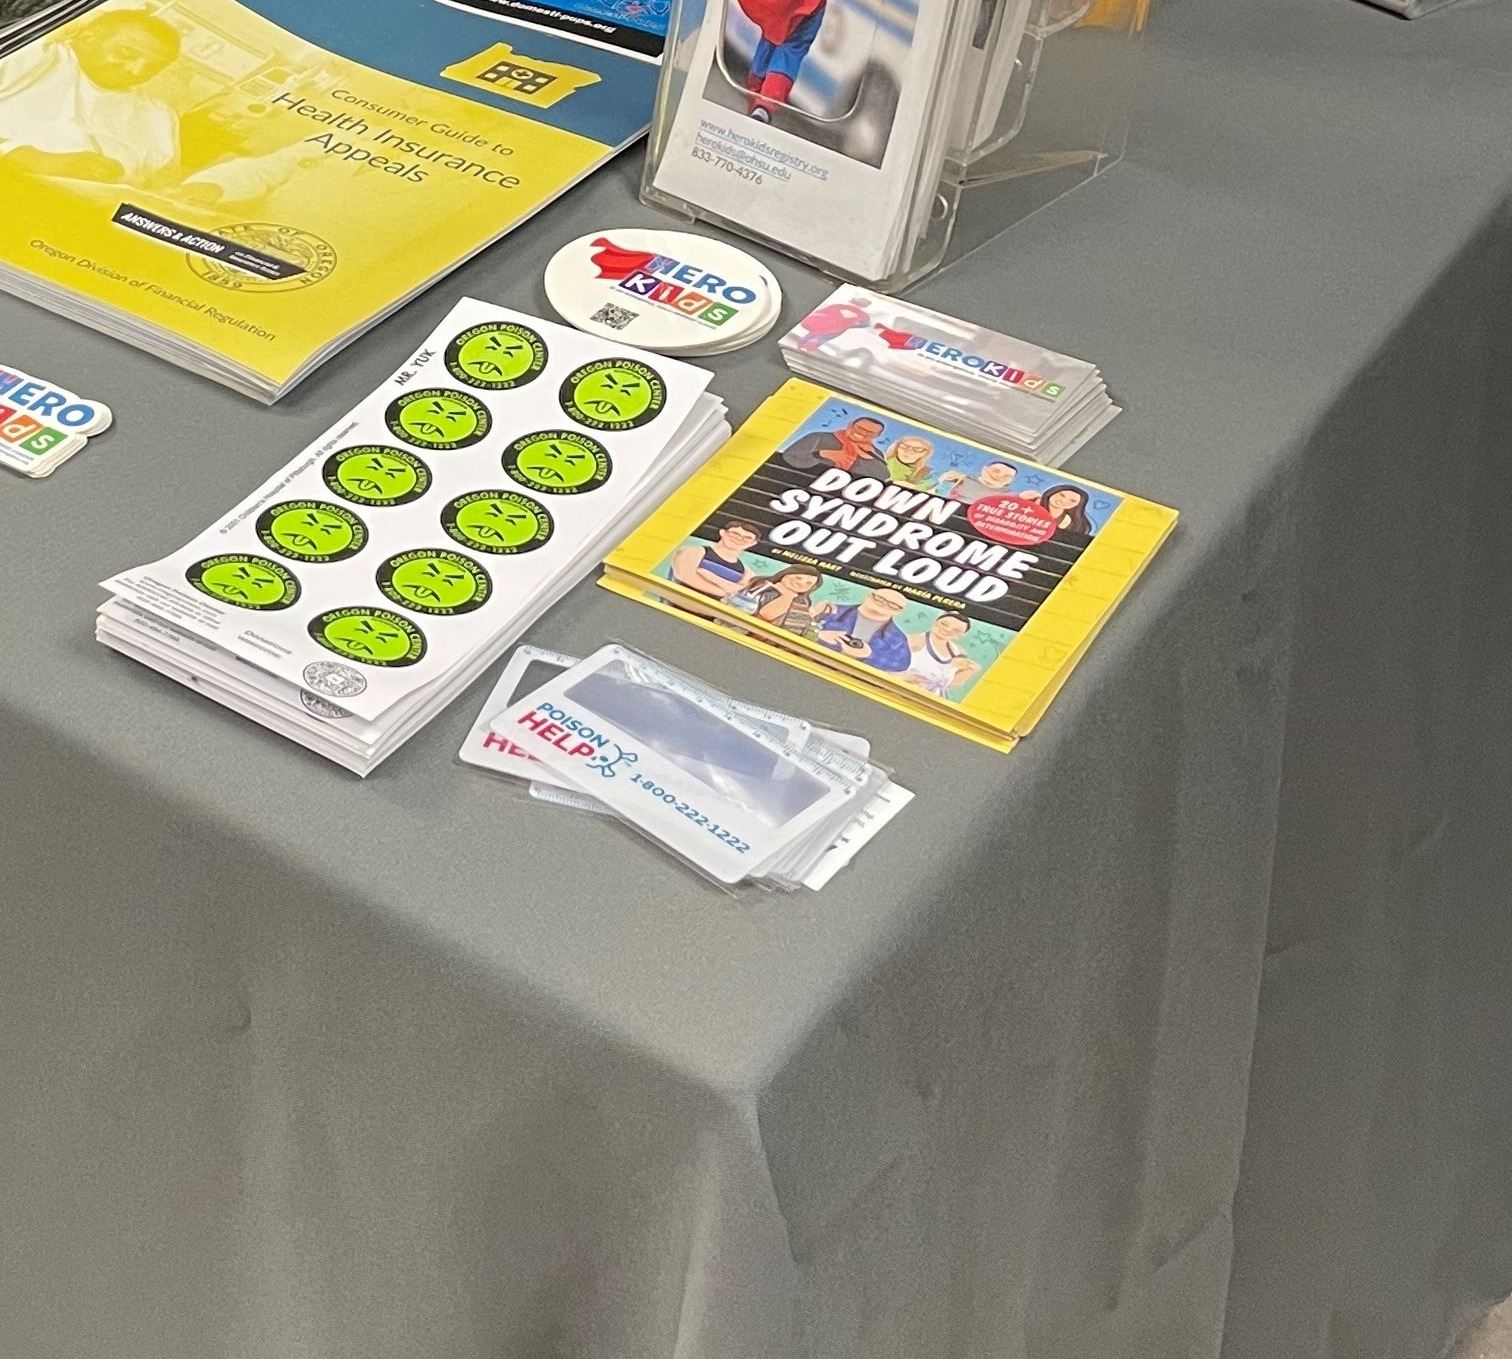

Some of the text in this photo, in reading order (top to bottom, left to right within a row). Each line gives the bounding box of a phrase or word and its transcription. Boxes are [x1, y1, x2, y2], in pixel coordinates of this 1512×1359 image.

[272, 92, 520, 189] Health Insurance
[331, 89, 514, 156] Consumer Guide to
[305, 133, 429, 183] Appeals
[691, 146, 763, 186] 833-770-4376
[120, 212, 225, 253] ANSWERS & ACTION
[30, 240, 76, 263] Oregon
[77, 259, 128, 282] Division
[144, 284, 206, 312] Financial
[205, 306, 276, 341] Regulation
[620, 272, 735, 327] Kids
[646, 253, 756, 307] HERO
[411, 349, 437, 368] YUK
[456, 324, 546, 370] OREGON POISON CENTER
[810, 467, 960, 524] DOWN
[976, 504, 1004, 516] TRUE
[1005, 512, 1051, 528] STORIES
[999, 500, 1019, 511] 20
[769, 489, 1038, 579] SYNDROME
[782, 550, 818, 566] MELISSA
[768, 520, 1008, 602] OUT LOUD
[517, 710, 595, 759] HELP
[536, 702, 609, 748] POISON
